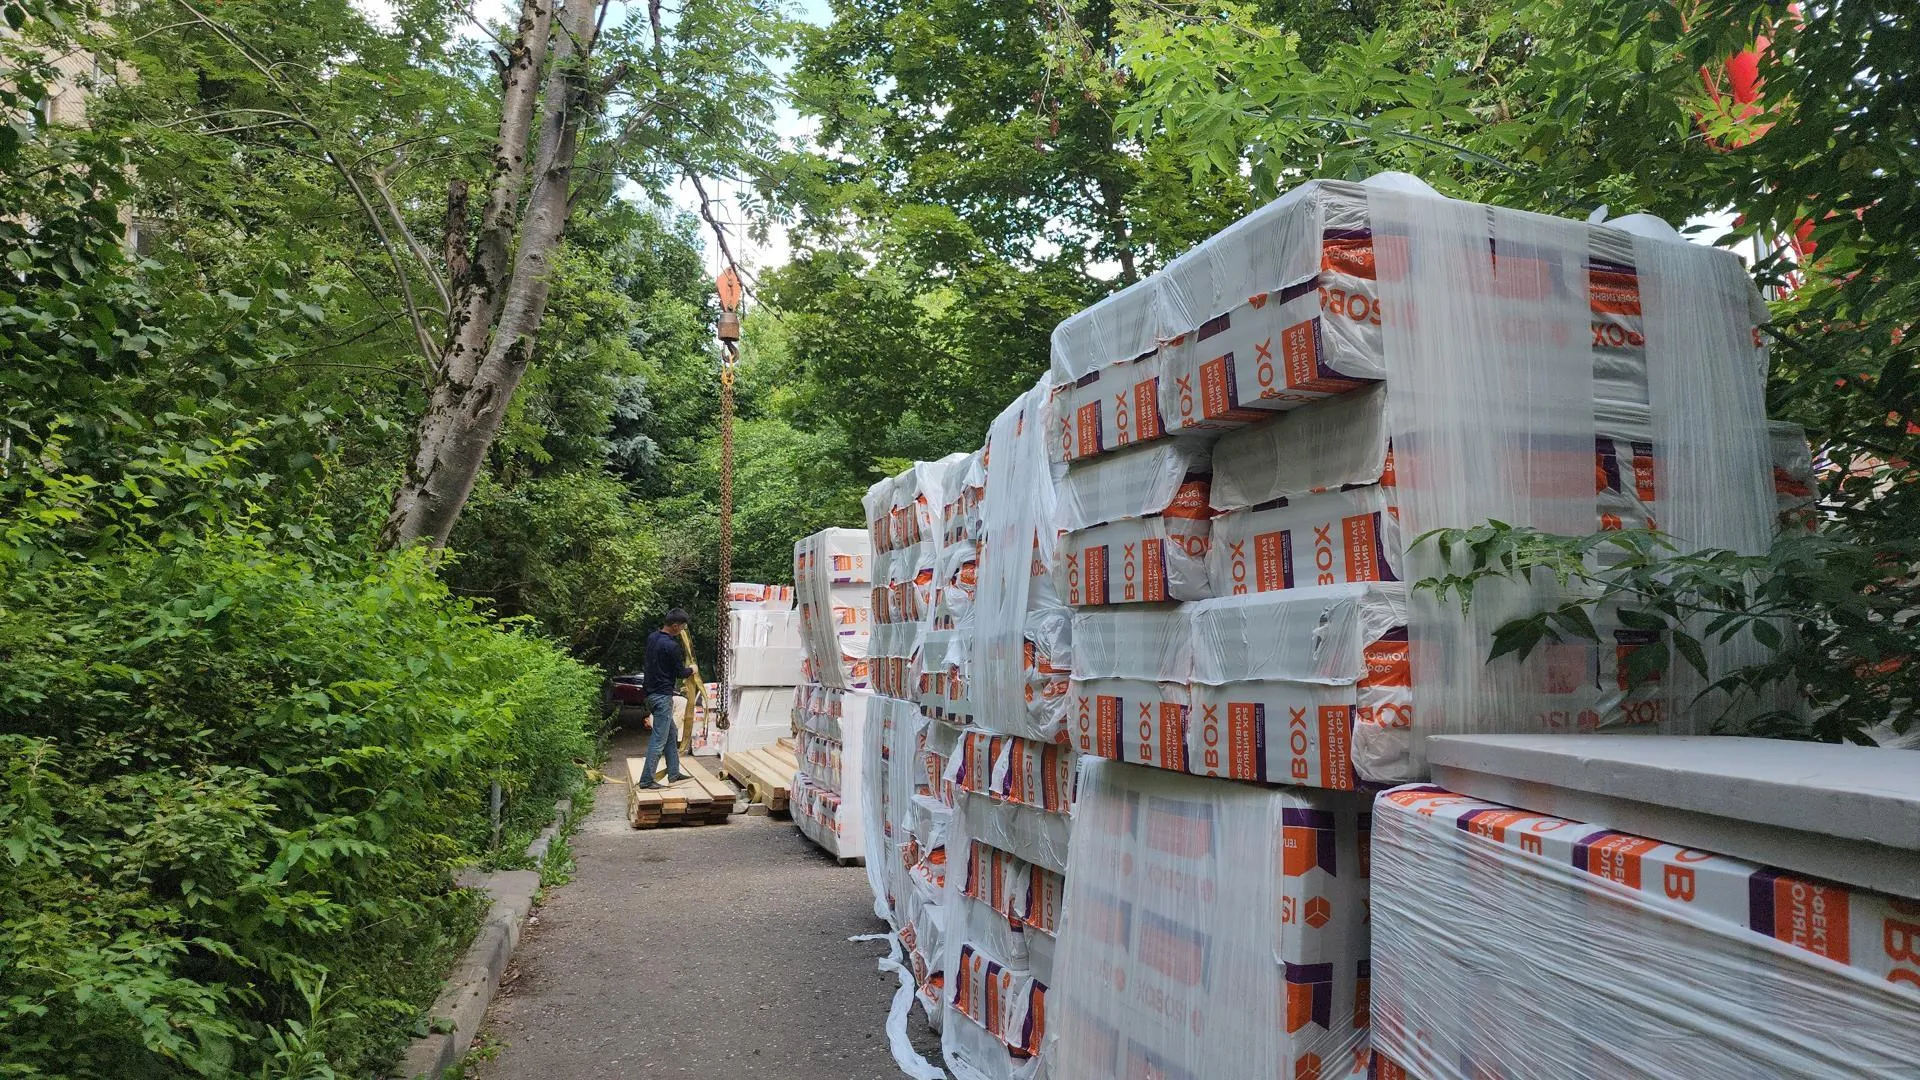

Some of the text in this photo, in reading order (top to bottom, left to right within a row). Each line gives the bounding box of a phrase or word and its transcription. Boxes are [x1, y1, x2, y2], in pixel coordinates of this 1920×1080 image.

[1297, 327, 1306, 350] XPS
[1255, 336, 1274, 399] BOX
[1115, 388, 1129, 446] BOX
[1268, 536, 1276, 557] XPS
[1313, 522, 1335, 586] BOX
[1351, 520, 1363, 581] ЕКТИВНАЯ
[1359, 519, 1368, 542] XPS
[1065, 551, 1080, 605] BOX
[1124, 541, 1136, 600] BOX
[1229, 539, 1248, 596] BOX
[1078, 696, 1091, 752] BOX
[1139, 701, 1152, 761] BOX
[1289, 706, 1309, 785] BOX
[1335, 710, 1344, 734] XPS
[1026, 754, 1035, 803] ISOB
